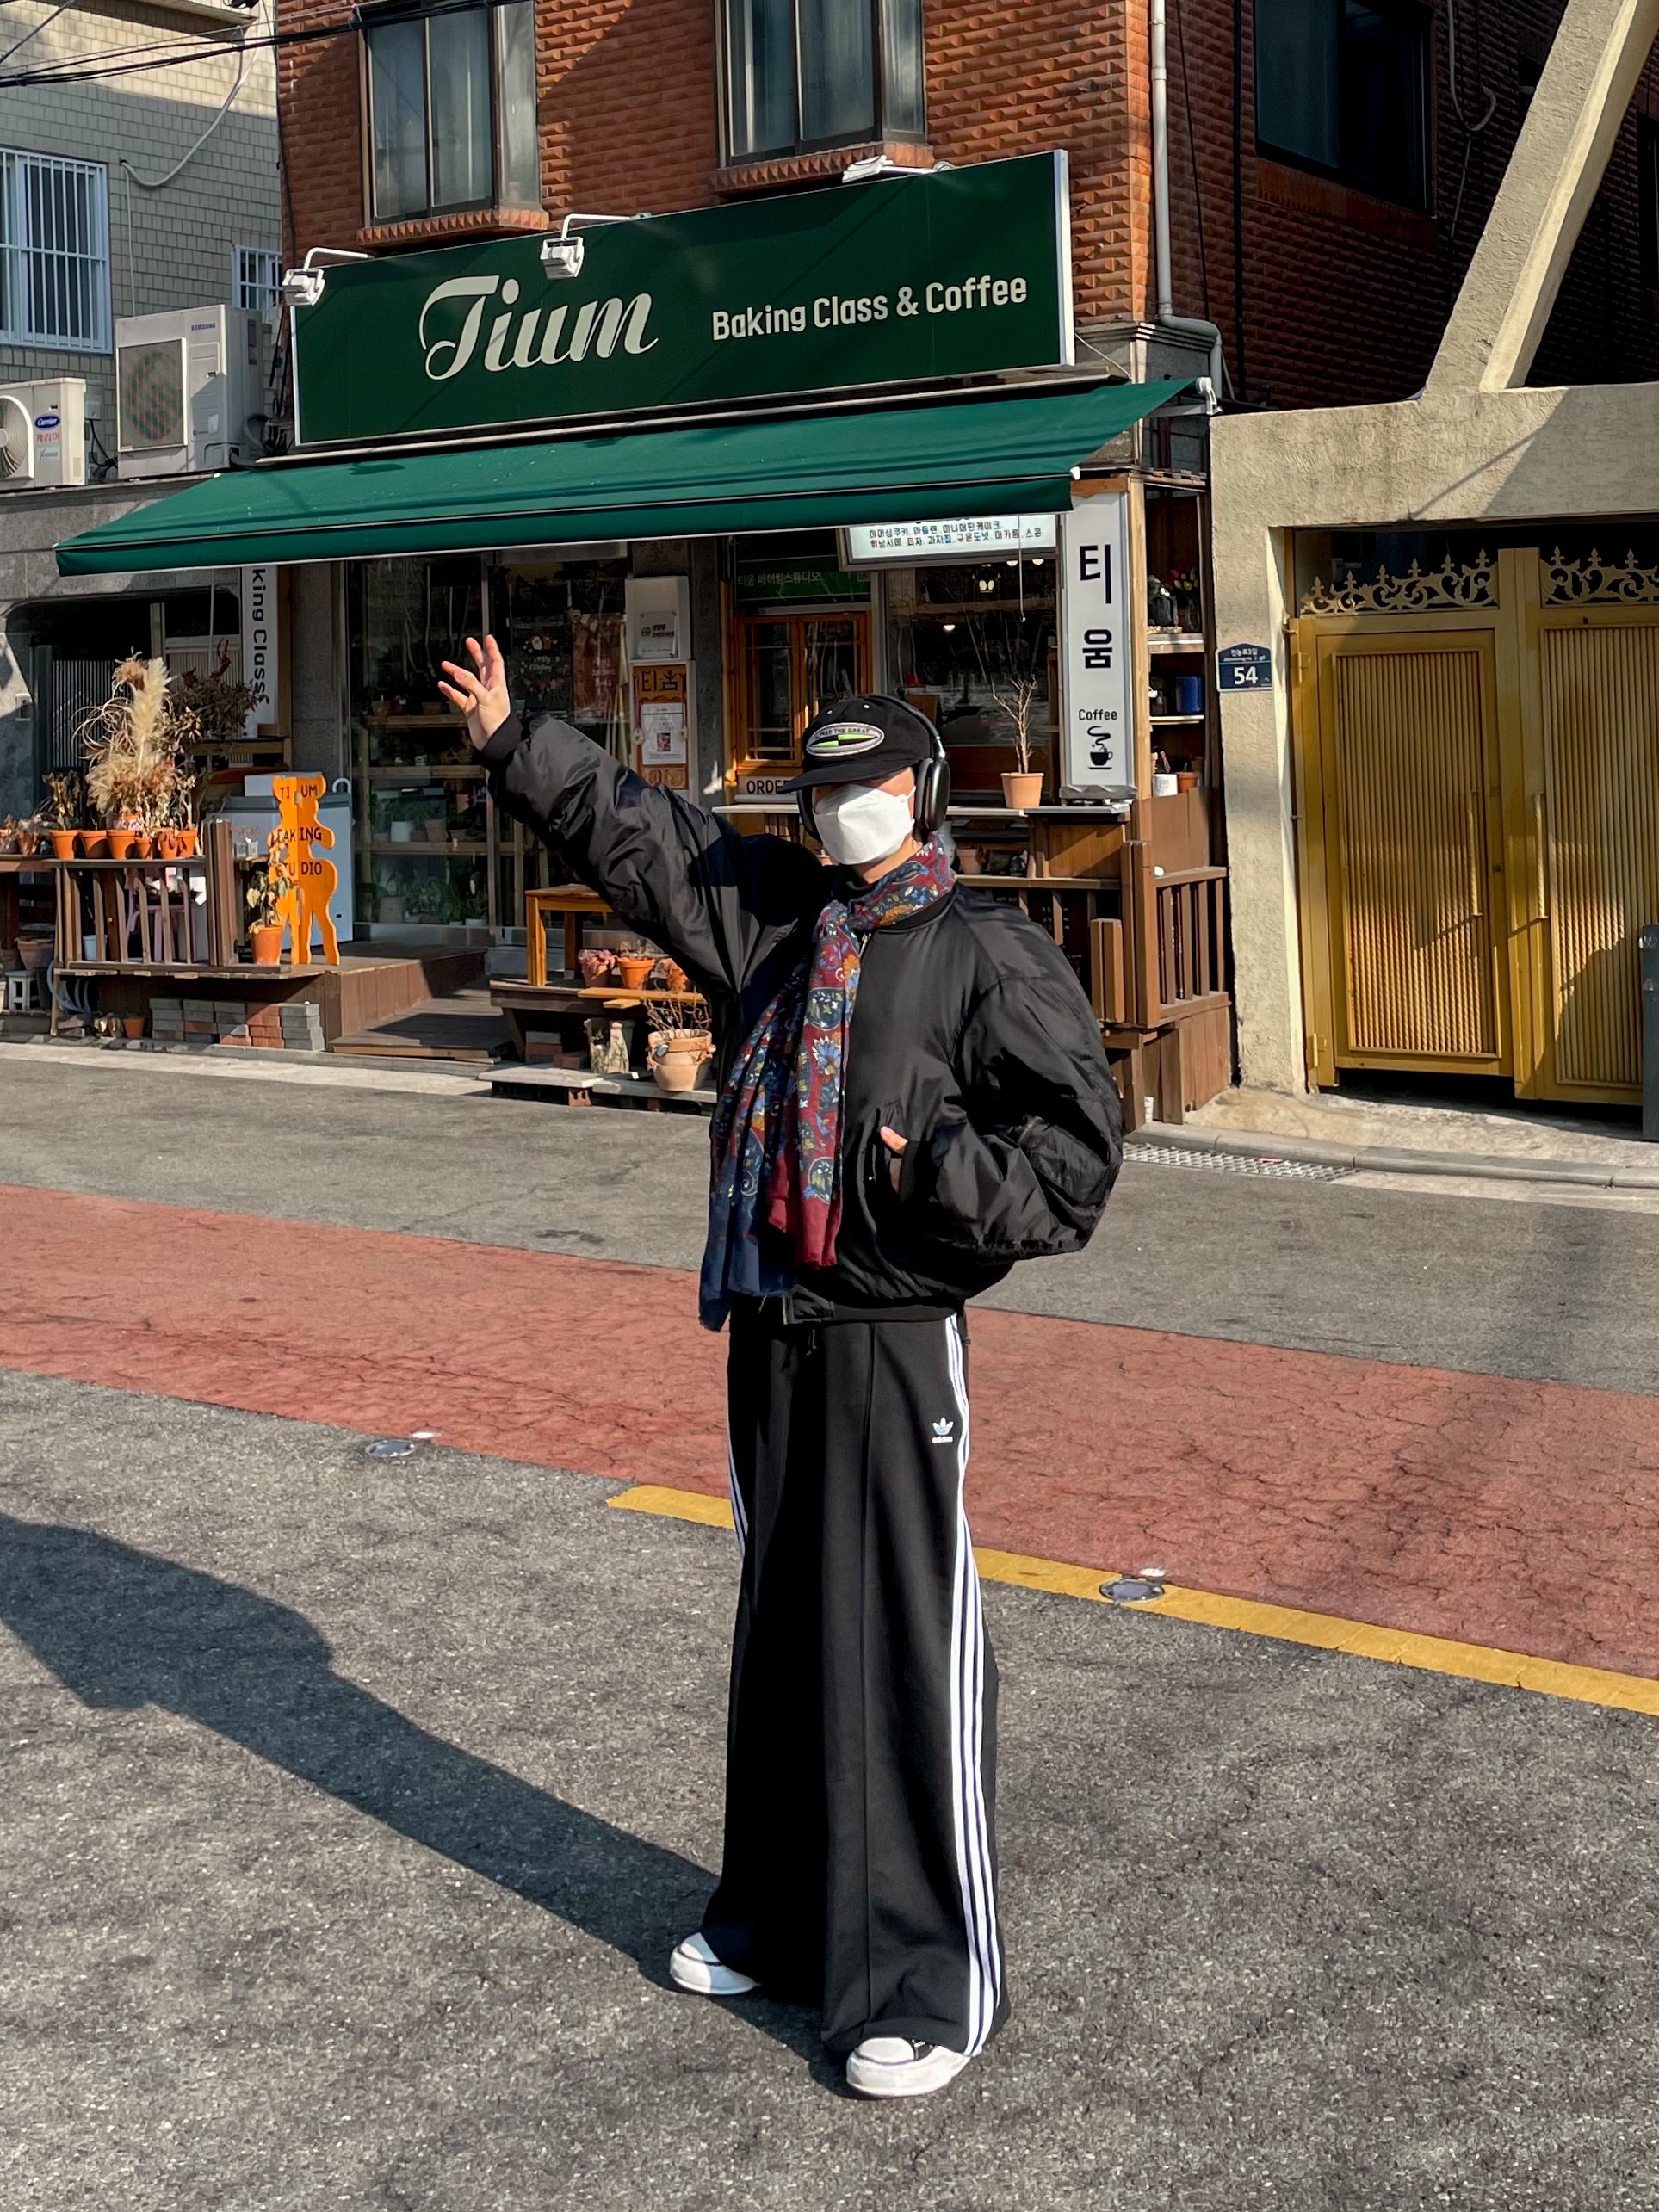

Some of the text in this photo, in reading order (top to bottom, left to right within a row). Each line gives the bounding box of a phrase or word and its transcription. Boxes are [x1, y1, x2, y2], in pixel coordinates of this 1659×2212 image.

[712, 275, 1028, 342] Baking Class & Coffee
[191, 323, 216, 331] SAMSUNG
[419, 275, 659, 380] Tium
[37, 417, 58, 427] Carrier
[253, 629, 268, 695] Class
[1234, 666, 1258, 685] 54
[1078, 708, 1117, 721] Coffee
